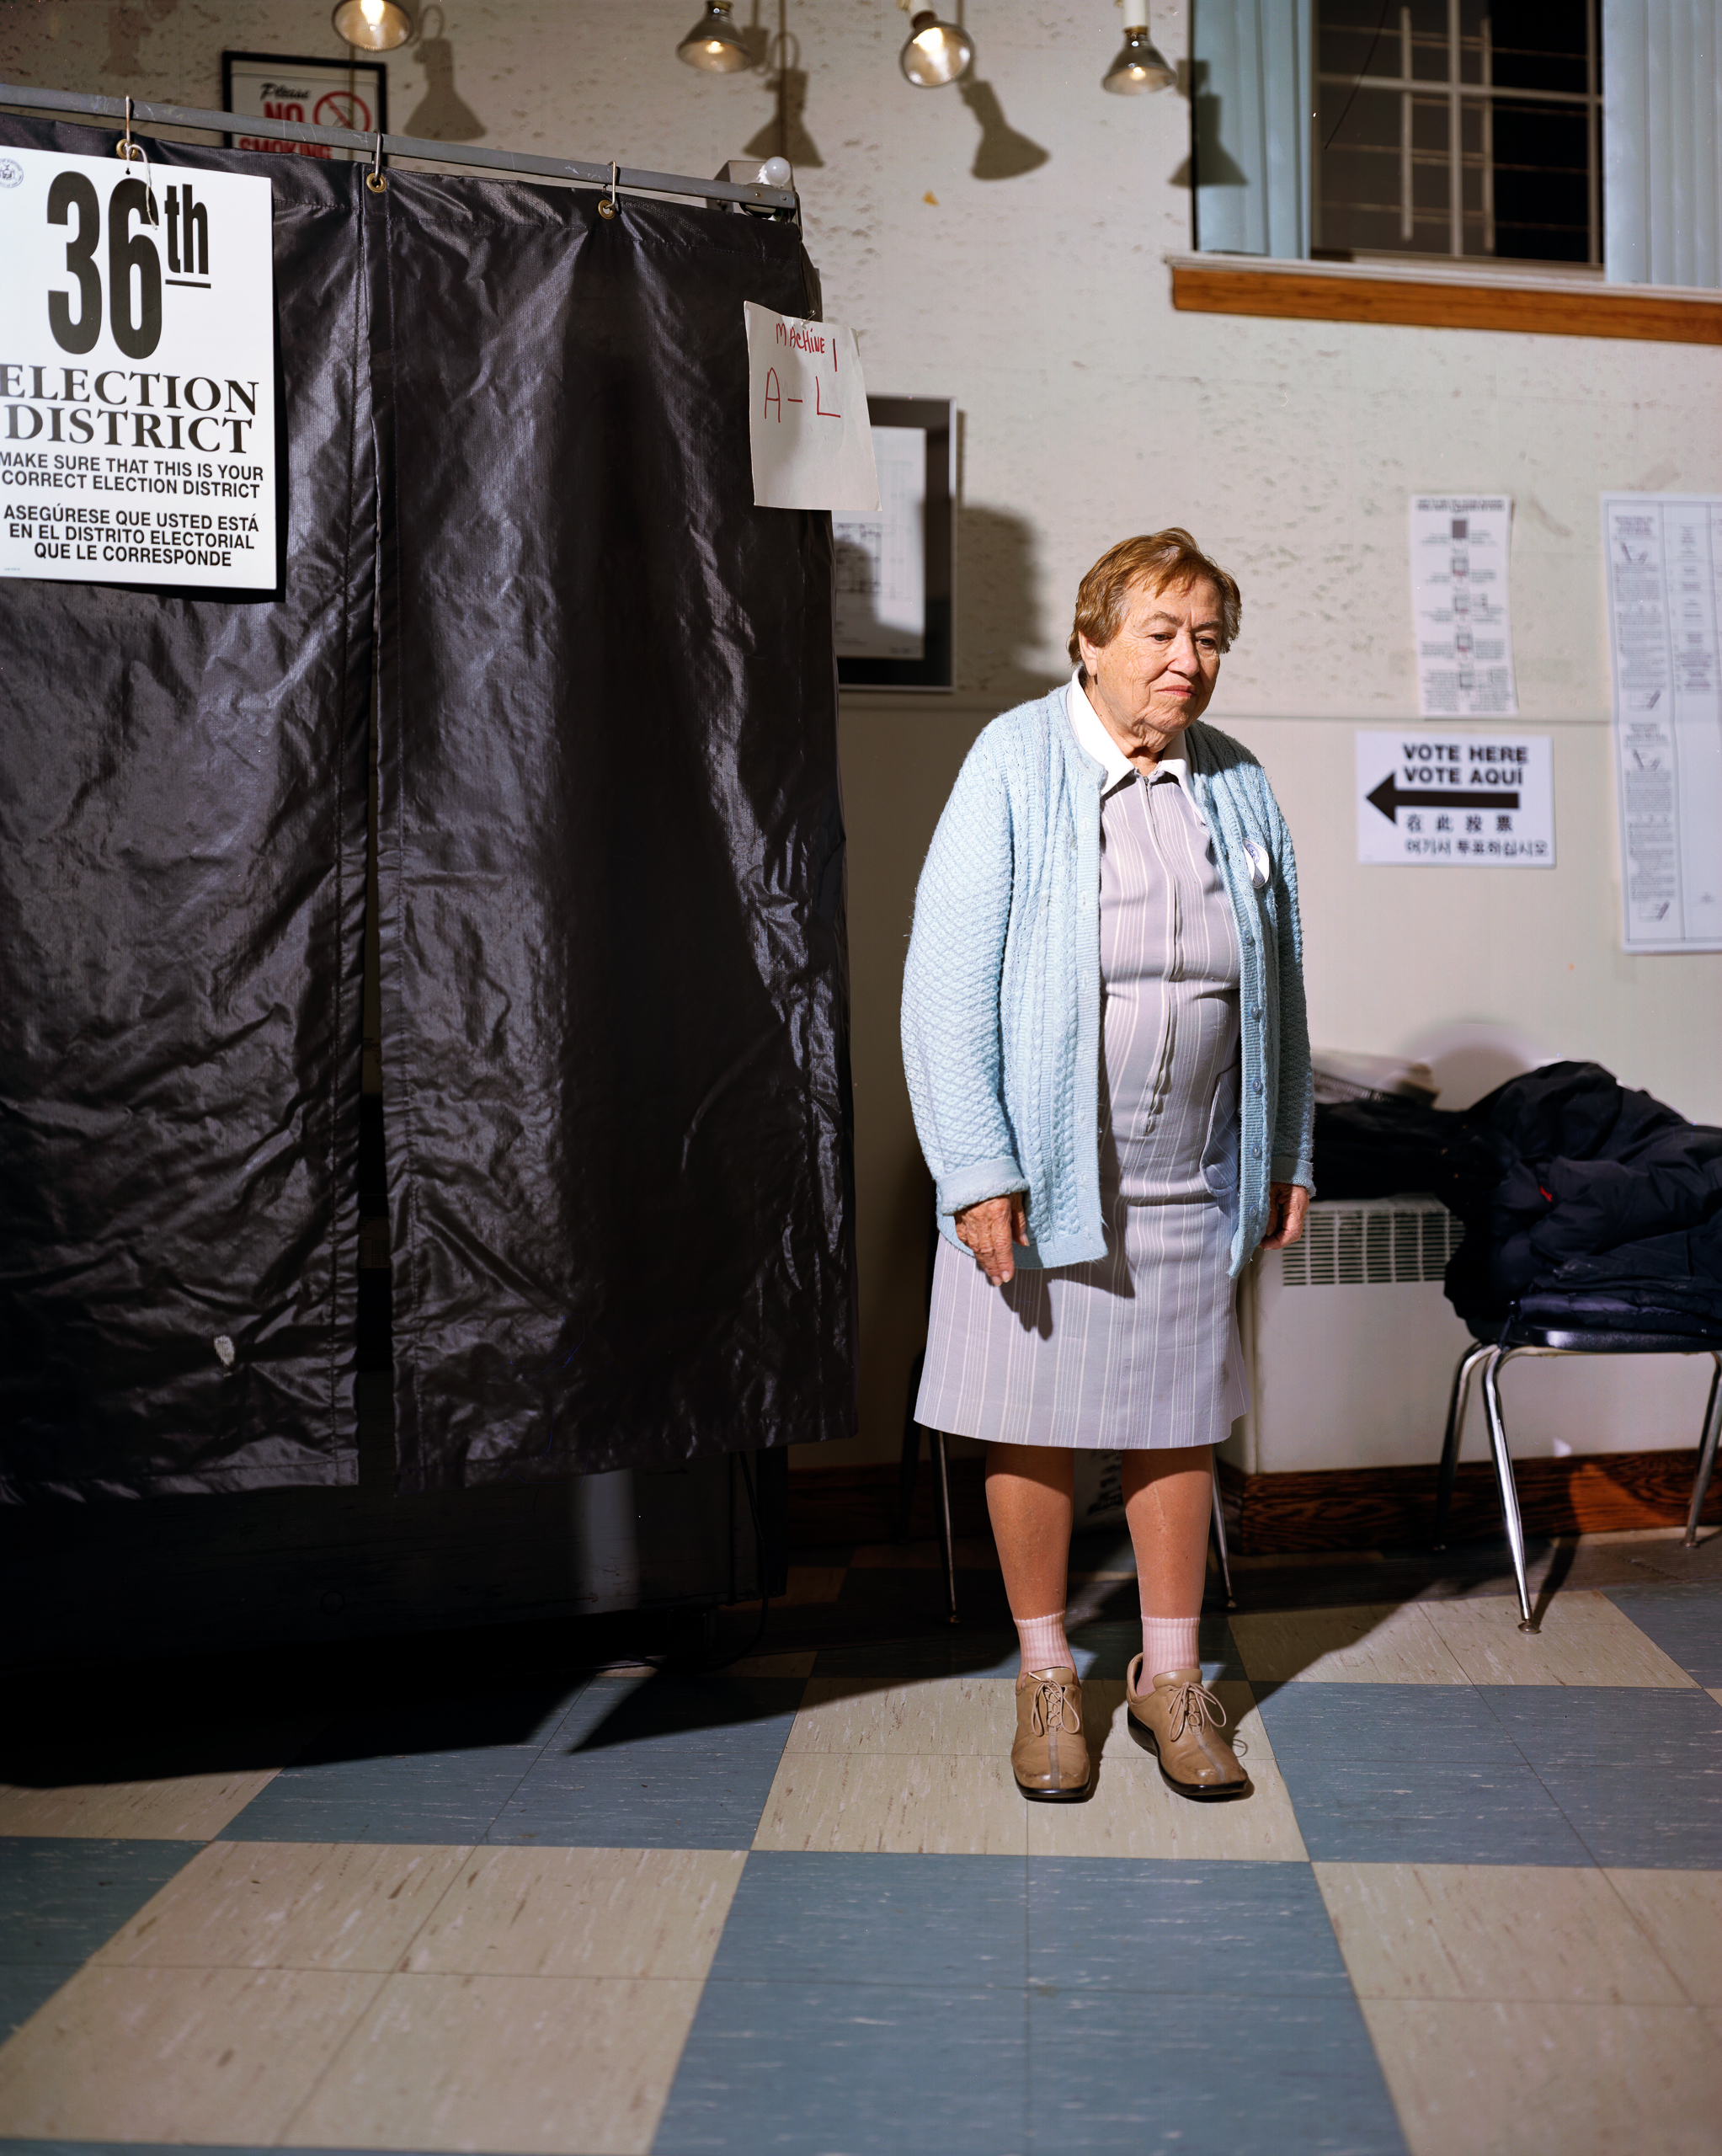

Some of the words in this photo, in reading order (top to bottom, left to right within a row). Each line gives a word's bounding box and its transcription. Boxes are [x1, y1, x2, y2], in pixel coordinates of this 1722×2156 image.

[260, 83, 311, 100] Please
[46, 171, 209, 360] 36th
[0, 363, 259, 415] ELECTION
[4, 404, 253, 454] DISTRICT
[0, 451, 48, 468] MAKE
[54, 455, 100, 472] SURE
[105, 457, 149, 474] THAT
[154, 461, 192, 477] THIS
[198, 463, 213, 478] IS
[217, 464, 264, 481] YOUR
[2, 470, 87, 488] CORRECT
[93, 475, 178, 494] ELECTION
[184, 480, 260, 499] DISTRICT
[3, 503, 110, 525] ASEGÚRESE
[115, 510, 151, 526] QUE
[157, 513, 211, 530] USTED
[218, 513, 259, 532] ESTÁ
[9, 523, 32, 539] EN
[39, 525, 60, 540] EL
[66, 526, 145, 544] DISTRITO
[151, 531, 255, 549] ELECTORIAL
[35, 542, 71, 559] QUE
[77, 544, 98, 561] LE
[103, 546, 232, 567] CORRESPONDE
[1404, 744, 1461, 761] VOTE
[1469, 745, 1528, 763] HERE
[1405, 766, 1461, 784] VOTE
